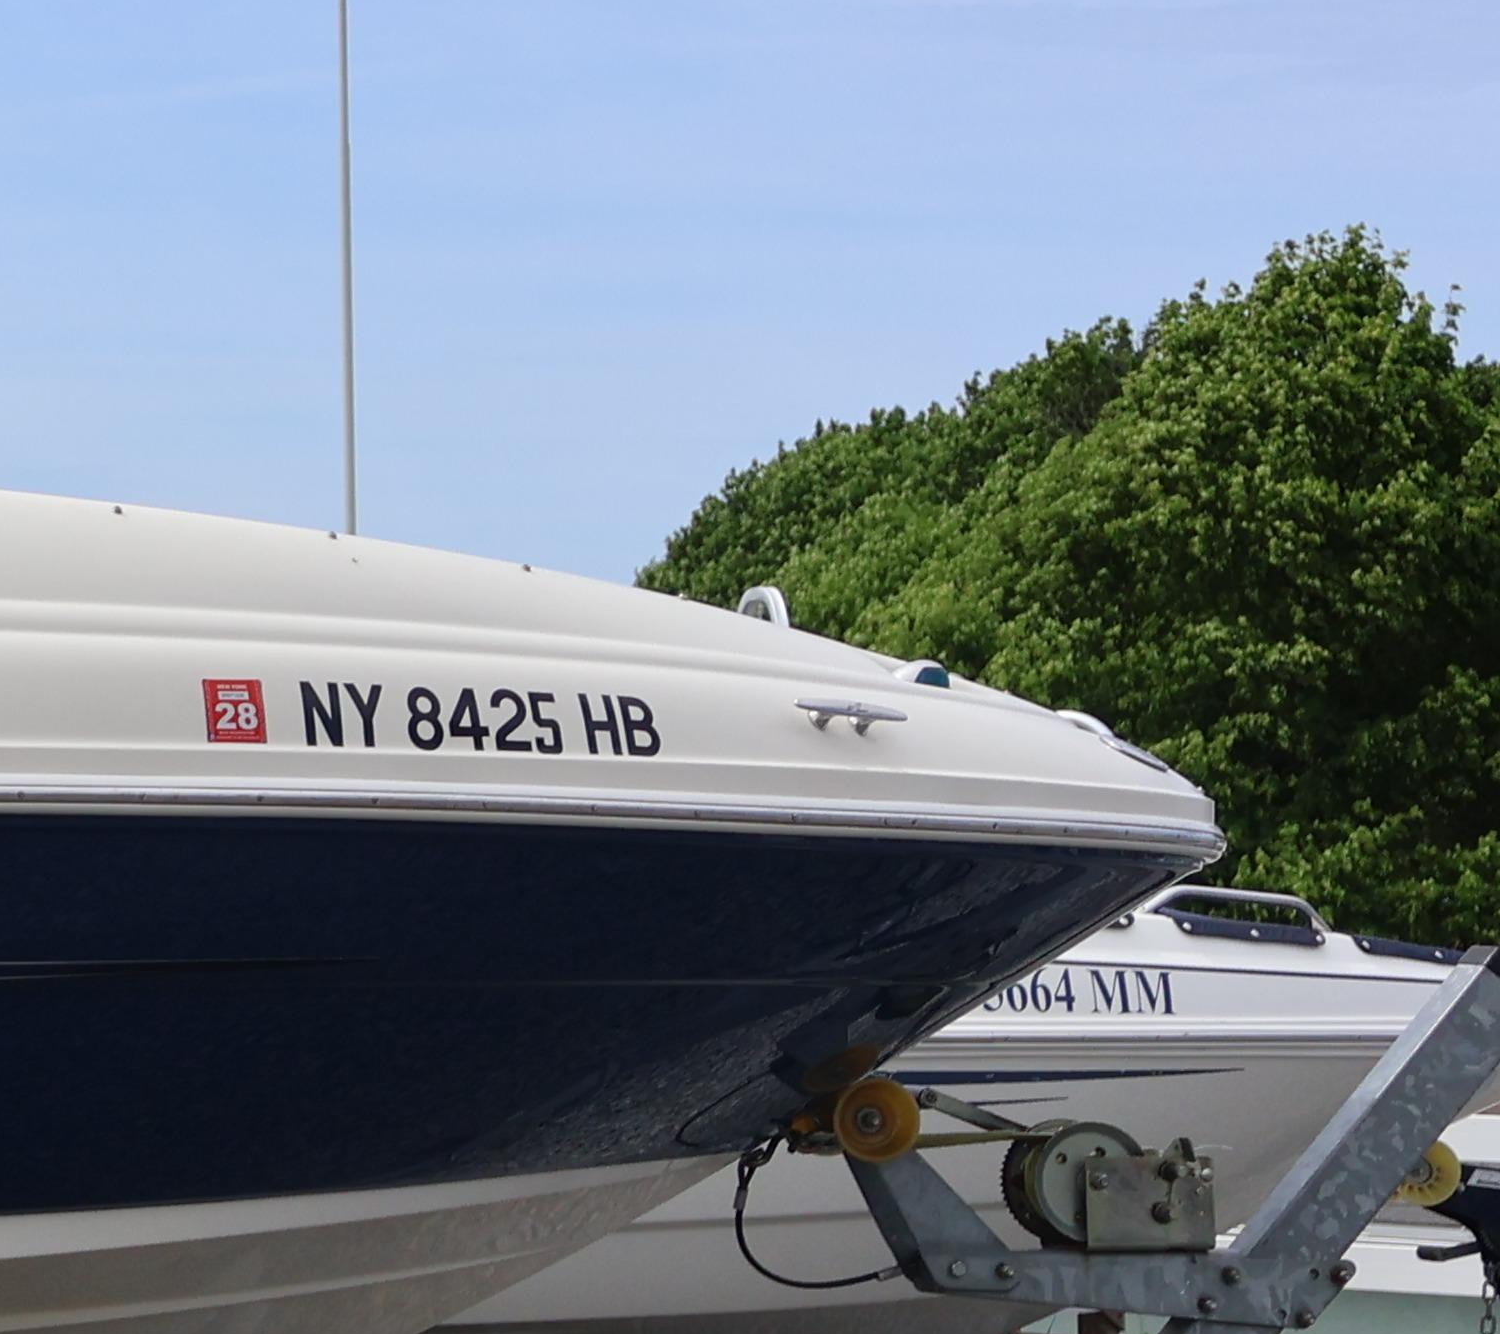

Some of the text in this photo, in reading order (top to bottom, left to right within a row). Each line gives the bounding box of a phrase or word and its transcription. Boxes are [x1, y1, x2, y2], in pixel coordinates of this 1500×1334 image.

[215, 702, 258, 730] 28
[300, 681, 661, 757] NY 8425 HB
[1089, 969, 1175, 1014] MM
